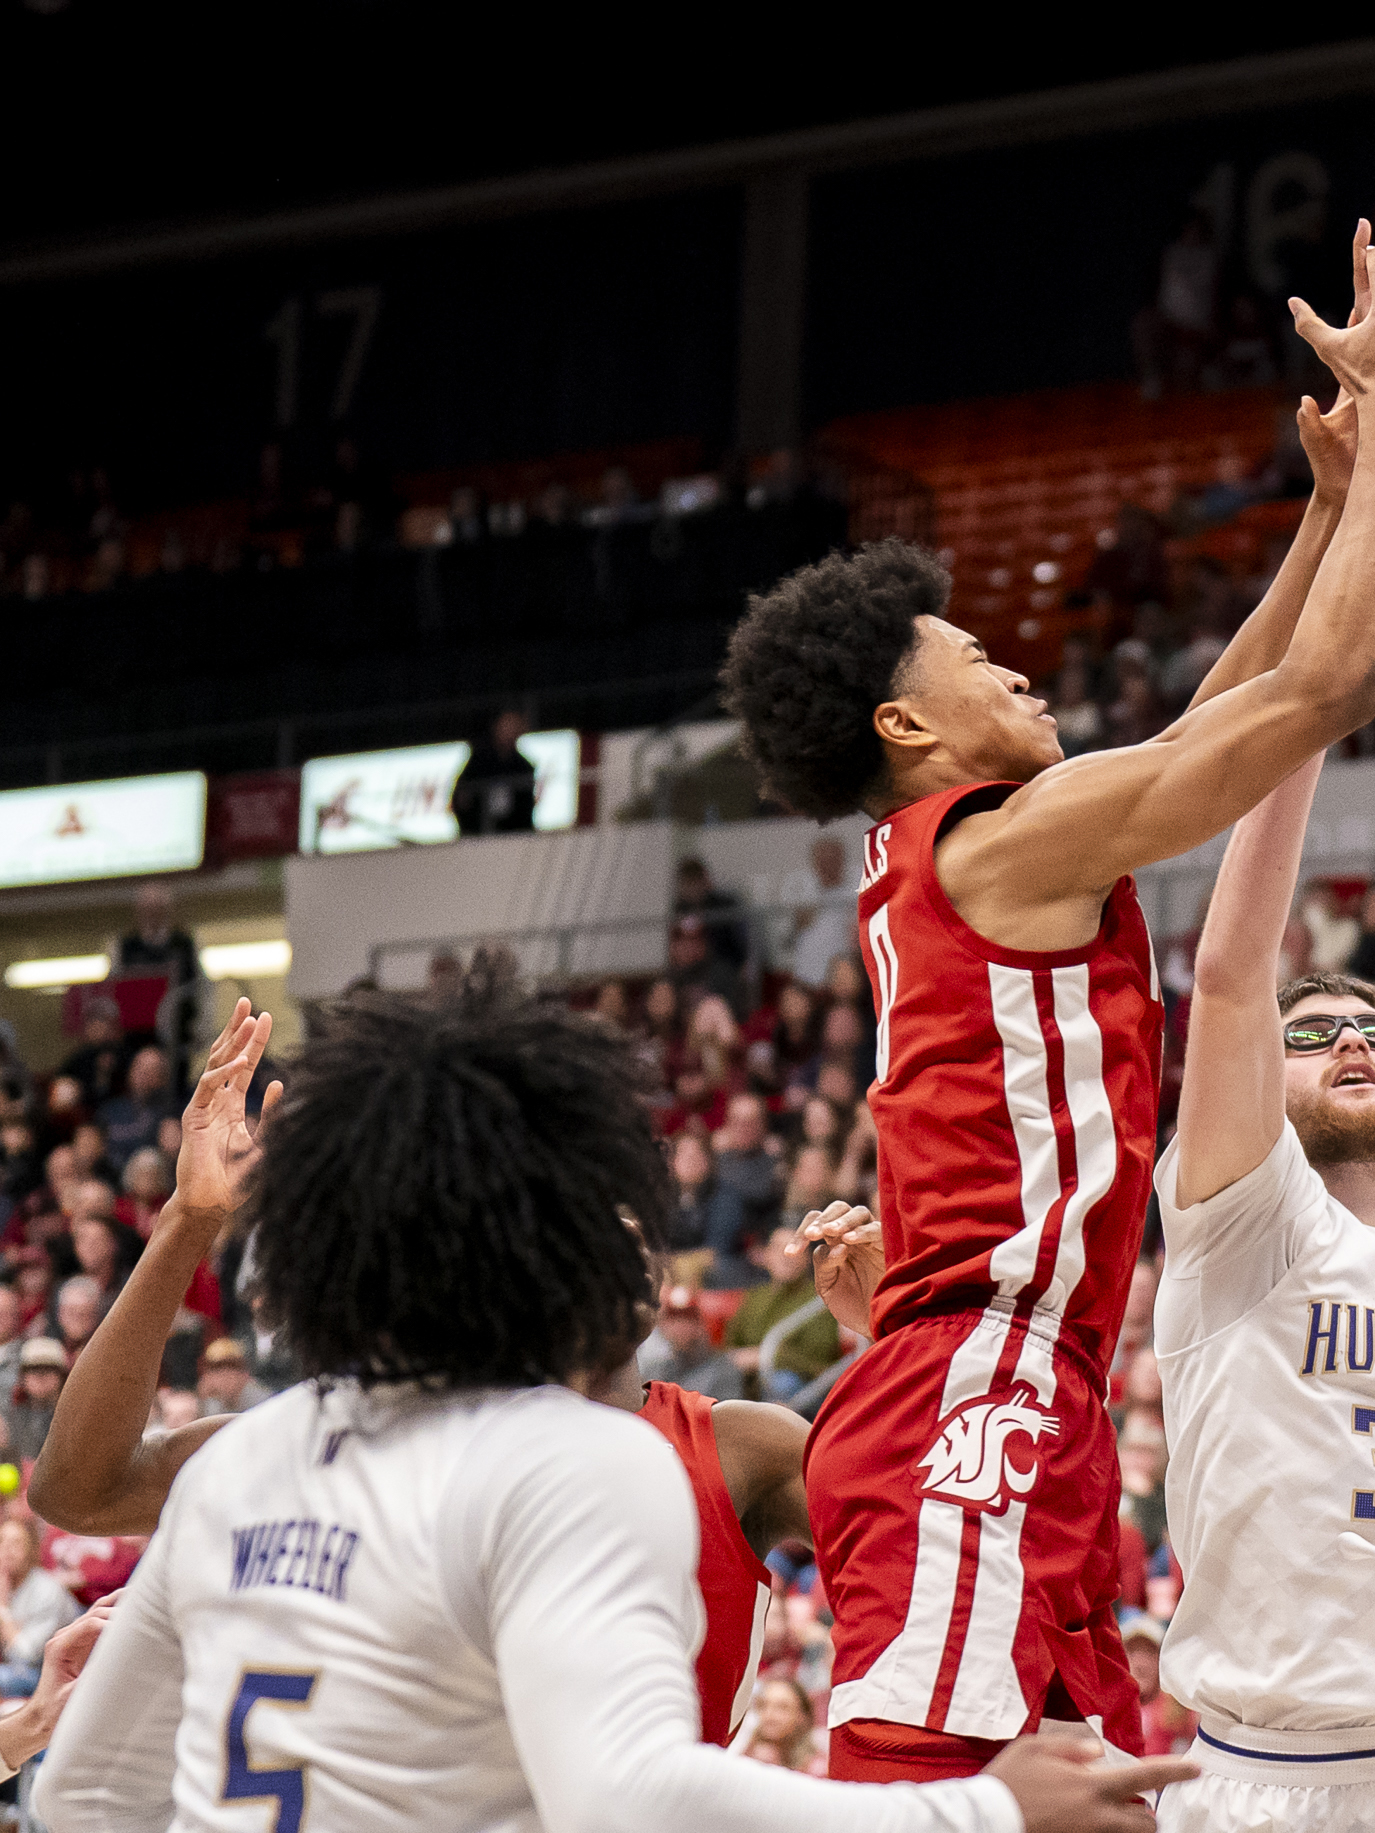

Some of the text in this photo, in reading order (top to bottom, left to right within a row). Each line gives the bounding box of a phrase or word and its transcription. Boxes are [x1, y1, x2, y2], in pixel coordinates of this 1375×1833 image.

[259, 284, 386, 427] 17
[230, 1517, 361, 1603] WHEELER
[218, 1660, 323, 1833] 5
